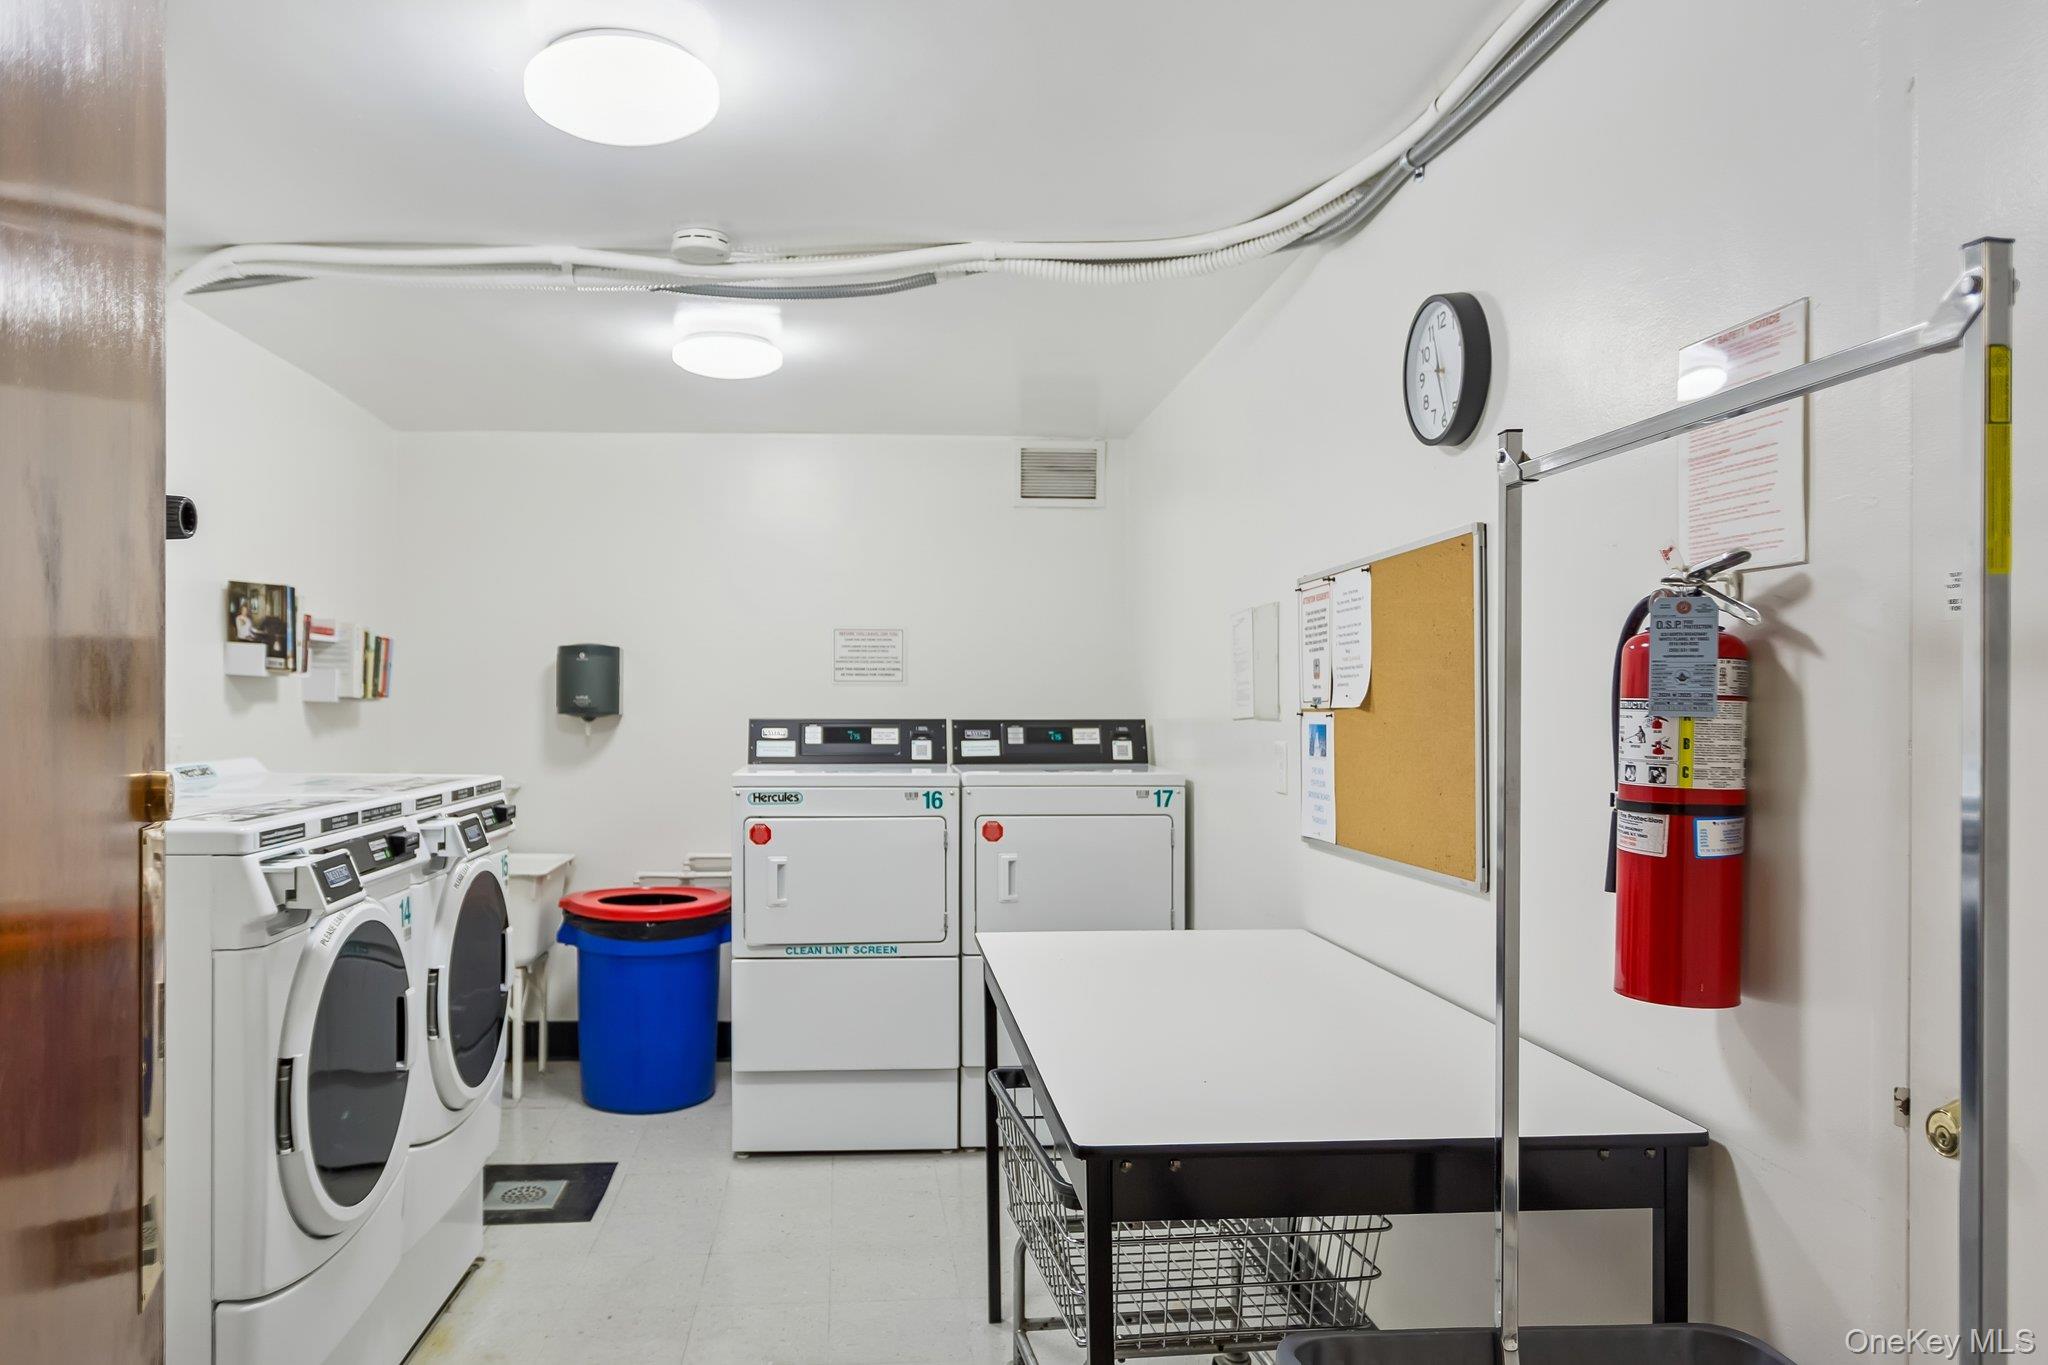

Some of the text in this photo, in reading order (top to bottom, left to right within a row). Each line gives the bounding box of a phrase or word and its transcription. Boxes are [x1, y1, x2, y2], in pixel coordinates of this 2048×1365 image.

[1437, 311, 1447, 330] 12
[1421, 346, 1431, 364] 10
[1419, 372, 1426, 390] 9
[1423, 394, 1430, 411] 8
[1430, 409, 1437, 425] 7
[1682, 738, 1690, 750] B
[1682, 766, 1690, 779] C
[753, 792, 800, 803] Hercules
[922, 791, 944, 810] 16
[1153, 790, 1174, 808] 17
[1628, 814, 1664, 824] Protection
[501, 855, 509, 878] 15
[400, 896, 411, 927] 14
[785, 945, 898, 955] CLEAN LINT SCREEN
